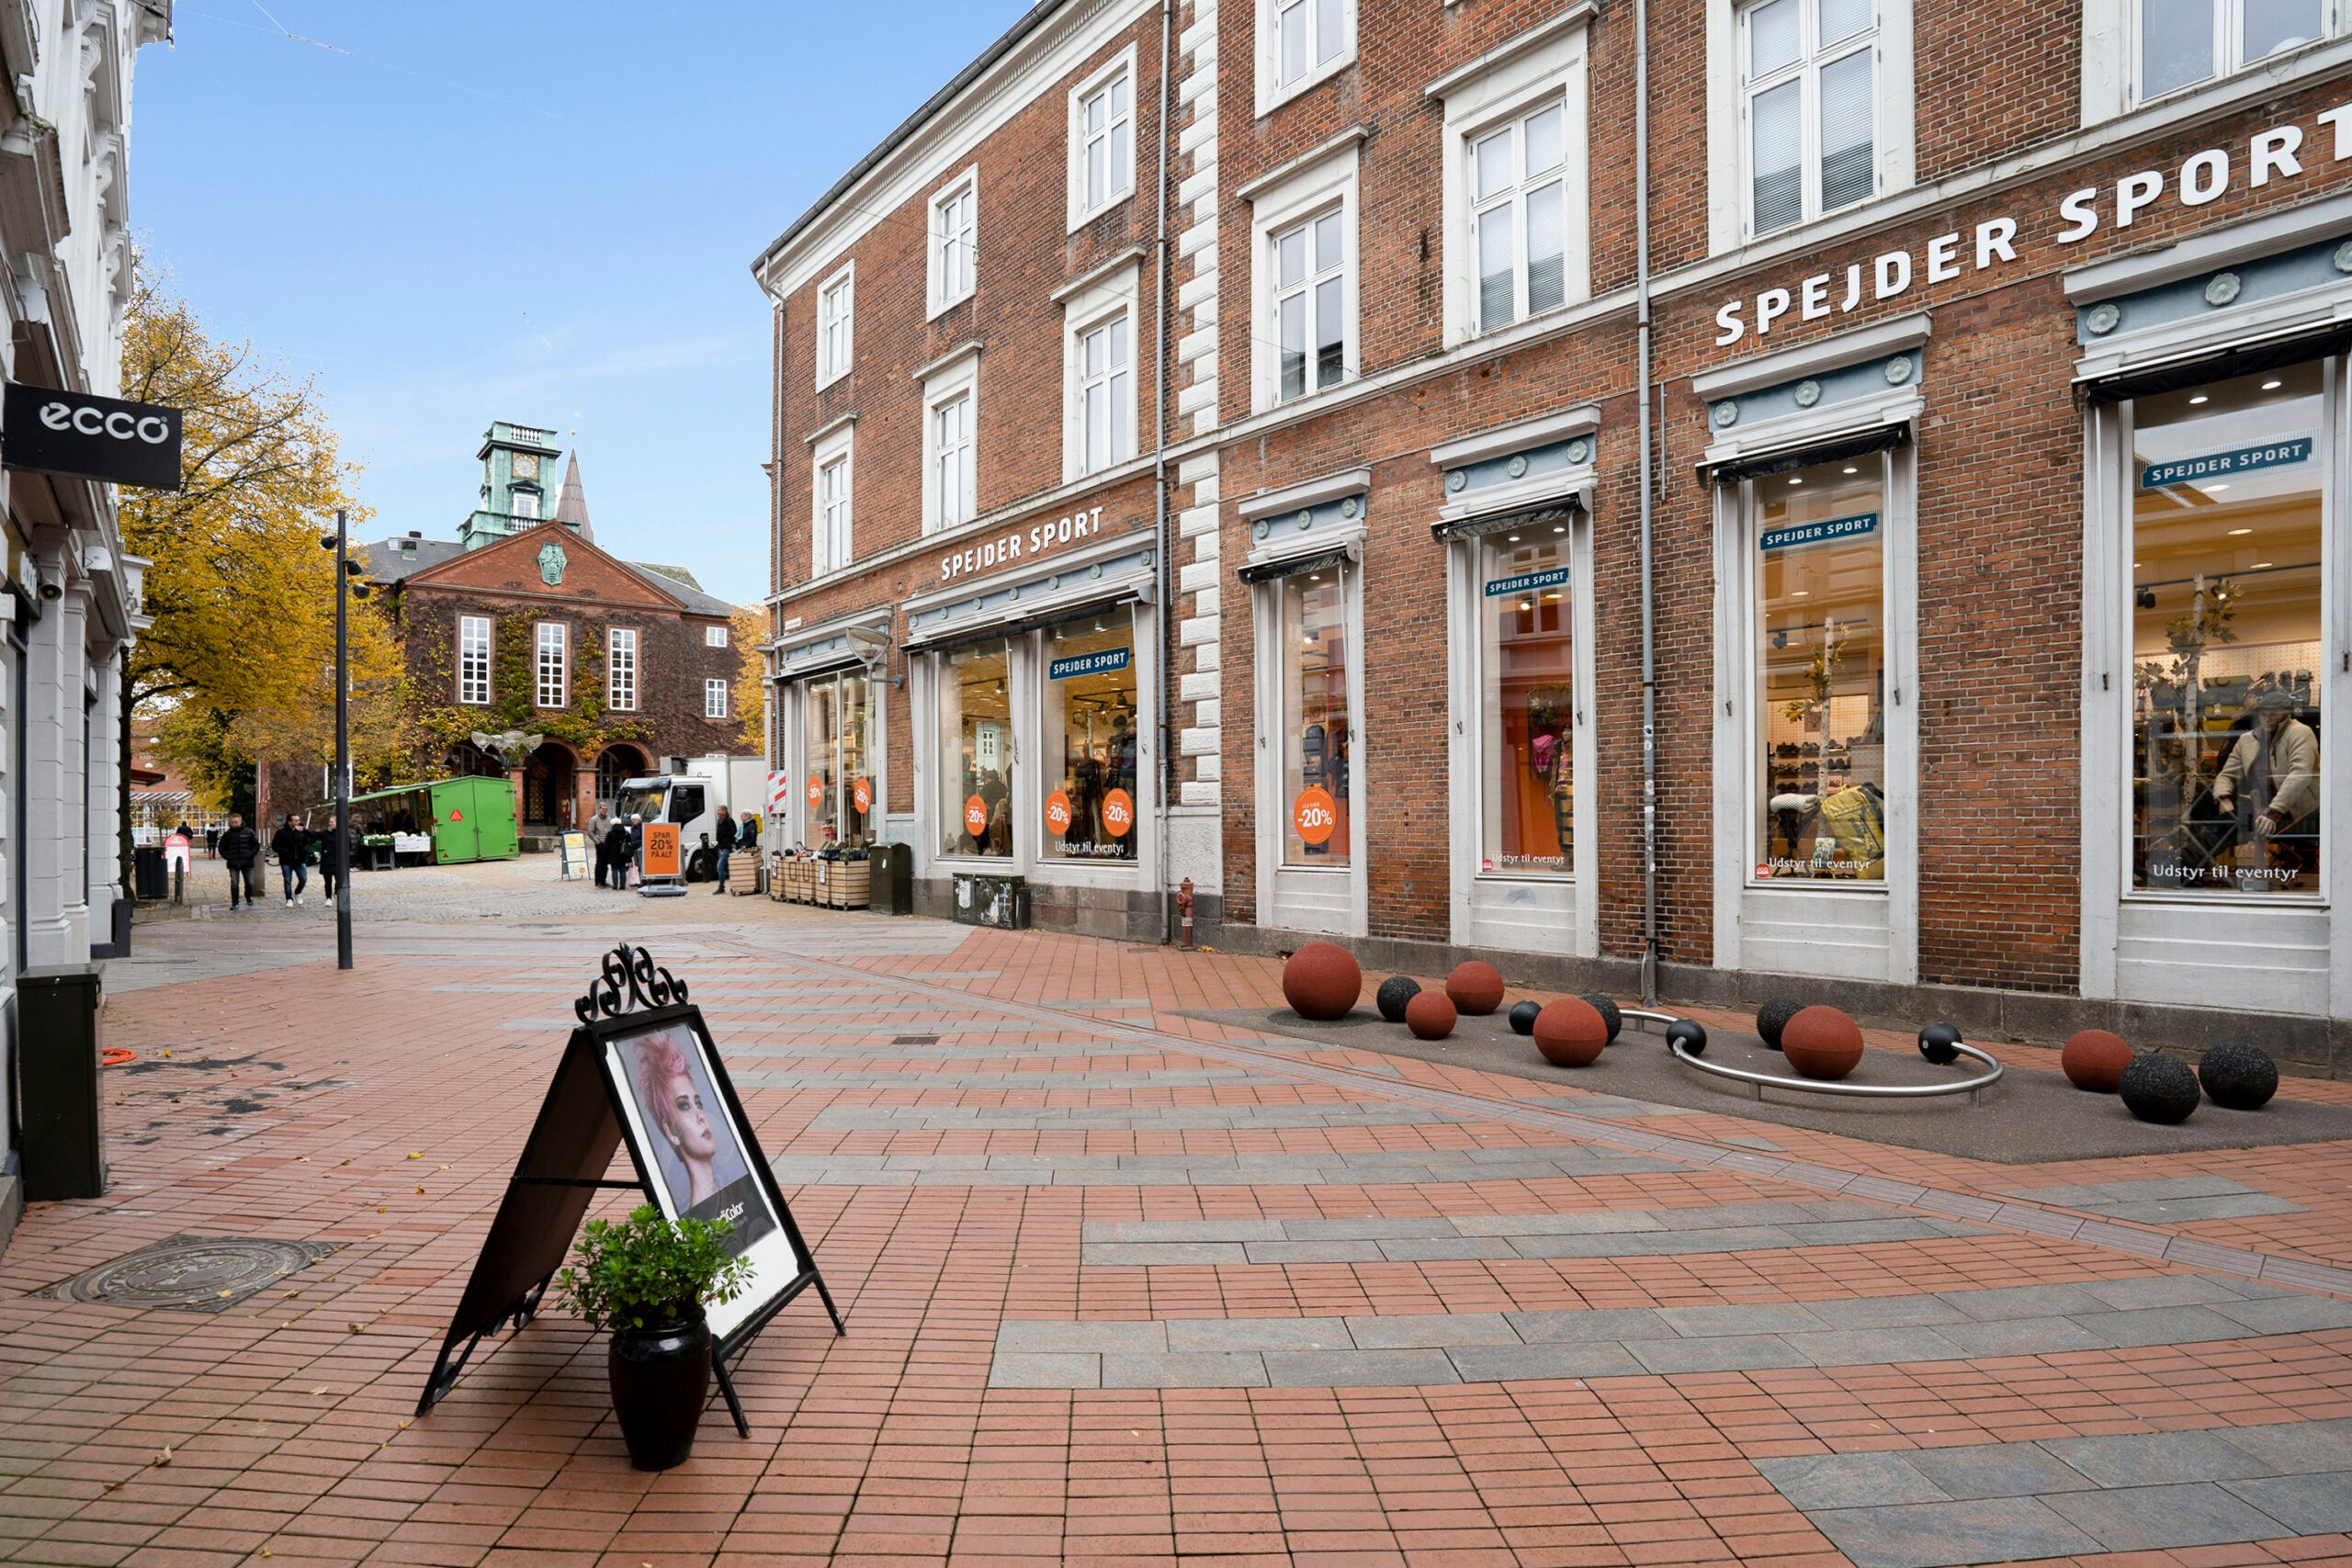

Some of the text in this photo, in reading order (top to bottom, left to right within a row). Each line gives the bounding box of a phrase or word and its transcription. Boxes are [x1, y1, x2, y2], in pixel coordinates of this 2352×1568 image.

[1715, 103, 2352, 347] SPEJDER SPORT
[40, 401, 169, 444] ecco
[2152, 444, 2302, 481] SPEJDER SPORT
[1766, 518, 1871, 545] SPEJDER SPORT
[941, 506, 1103, 581] SPEJDER SPORT
[1489, 571, 1565, 592] SPEJDER SPORT
[1053, 652, 1125, 675] SPEJDER SPORT
[967, 809, 986, 825] -20%
[1046, 805, 1069, 825] -20%
[1104, 805, 1130, 824] -20%
[1297, 807, 1333, 828] -20%
[650, 839, 673, 851] 20%
[650, 850, 660, 858] PÅ
[1055, 840, 1080, 854] Udstyr
[1082, 841, 1091, 853] til
[1492, 852, 1565, 864] Udstyr til eventyr
[1769, 857, 1871, 871] Udstyr til eventyr
[2153, 863, 2299, 882] Udstyr til eventyr
